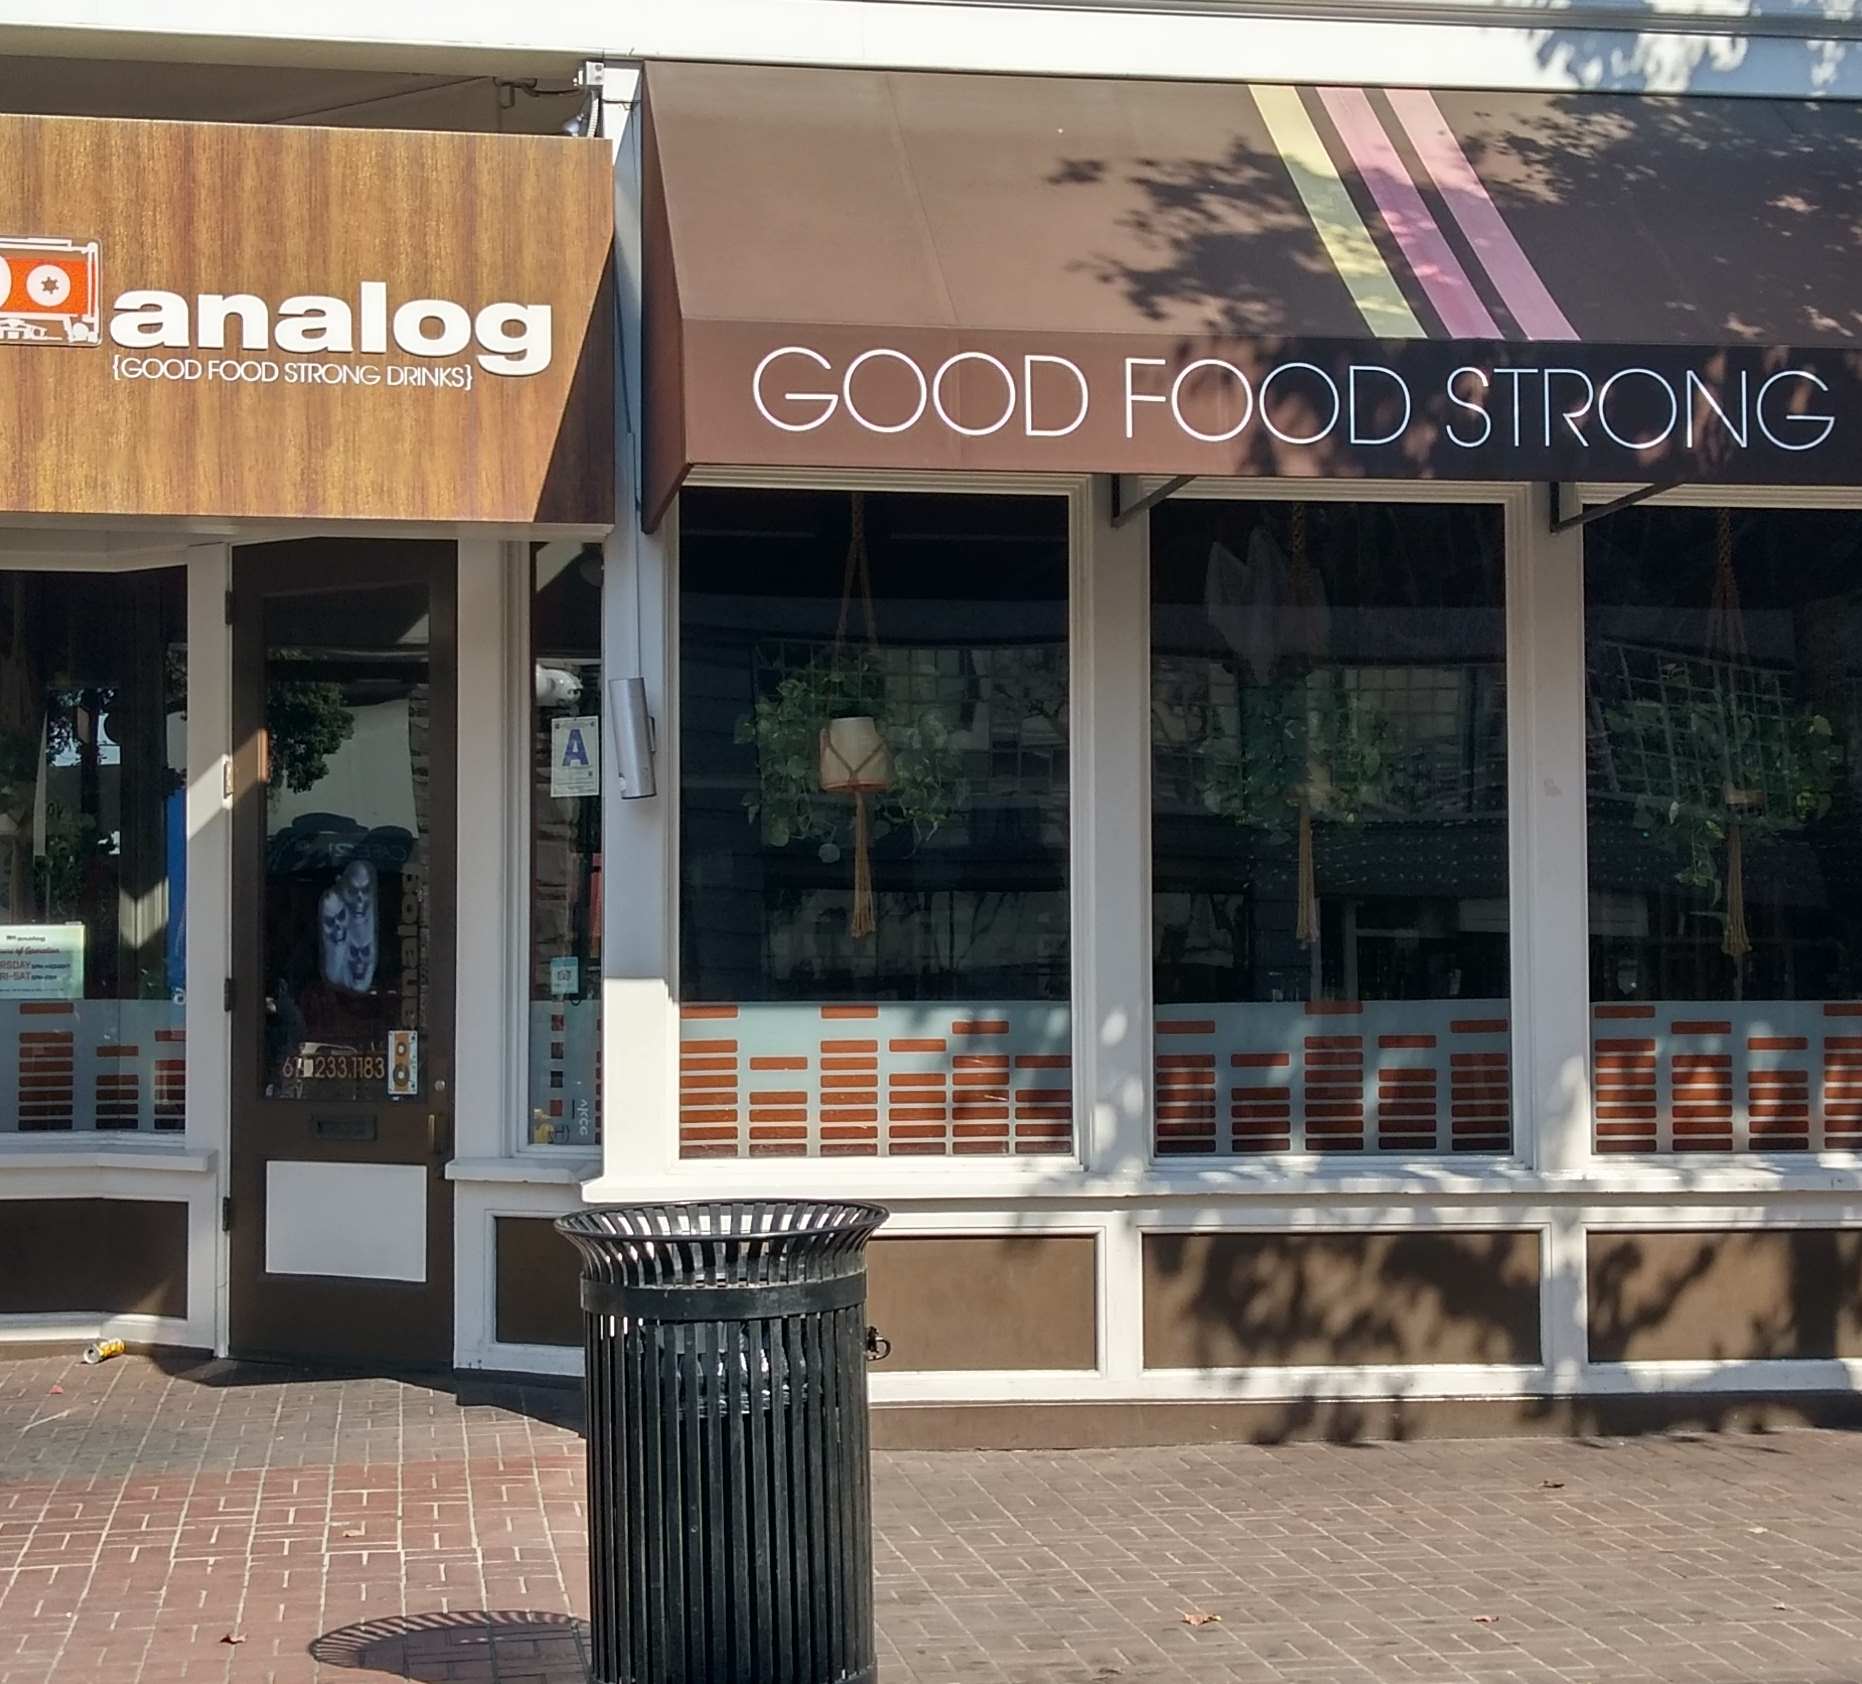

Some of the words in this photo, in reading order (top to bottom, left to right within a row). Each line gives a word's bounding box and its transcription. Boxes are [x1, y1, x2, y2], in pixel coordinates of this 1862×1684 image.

[109, 281, 552, 376] analog
[207, 359, 279, 383] FOOD
[284, 362, 382, 386] STRONG
[752, 345, 1089, 437] GOOD
[1125, 356, 1412, 446] FOOD
[1445, 366, 1836, 451] STRONG
[562, 728, 590, 767] A
